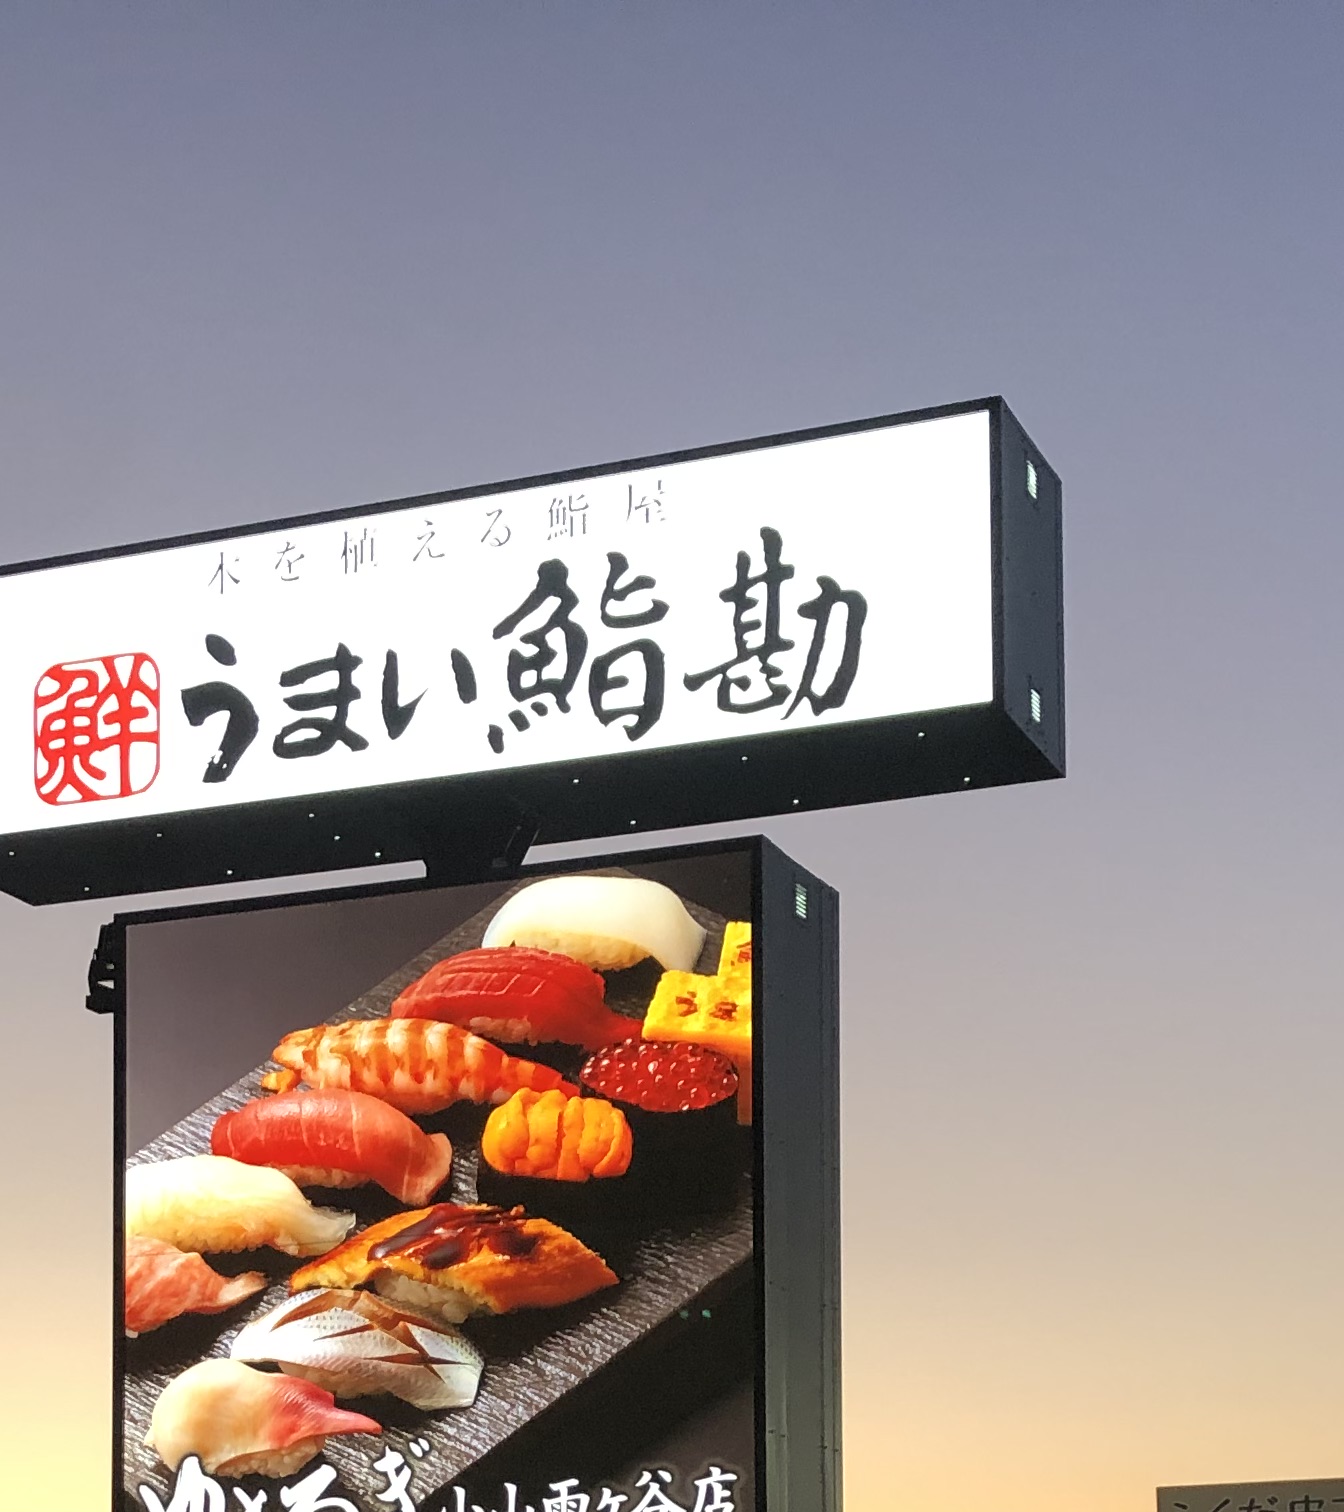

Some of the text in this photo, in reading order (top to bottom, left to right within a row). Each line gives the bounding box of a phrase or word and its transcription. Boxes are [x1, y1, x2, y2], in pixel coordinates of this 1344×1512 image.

[180, 526, 867, 784] うまい鮨勘
